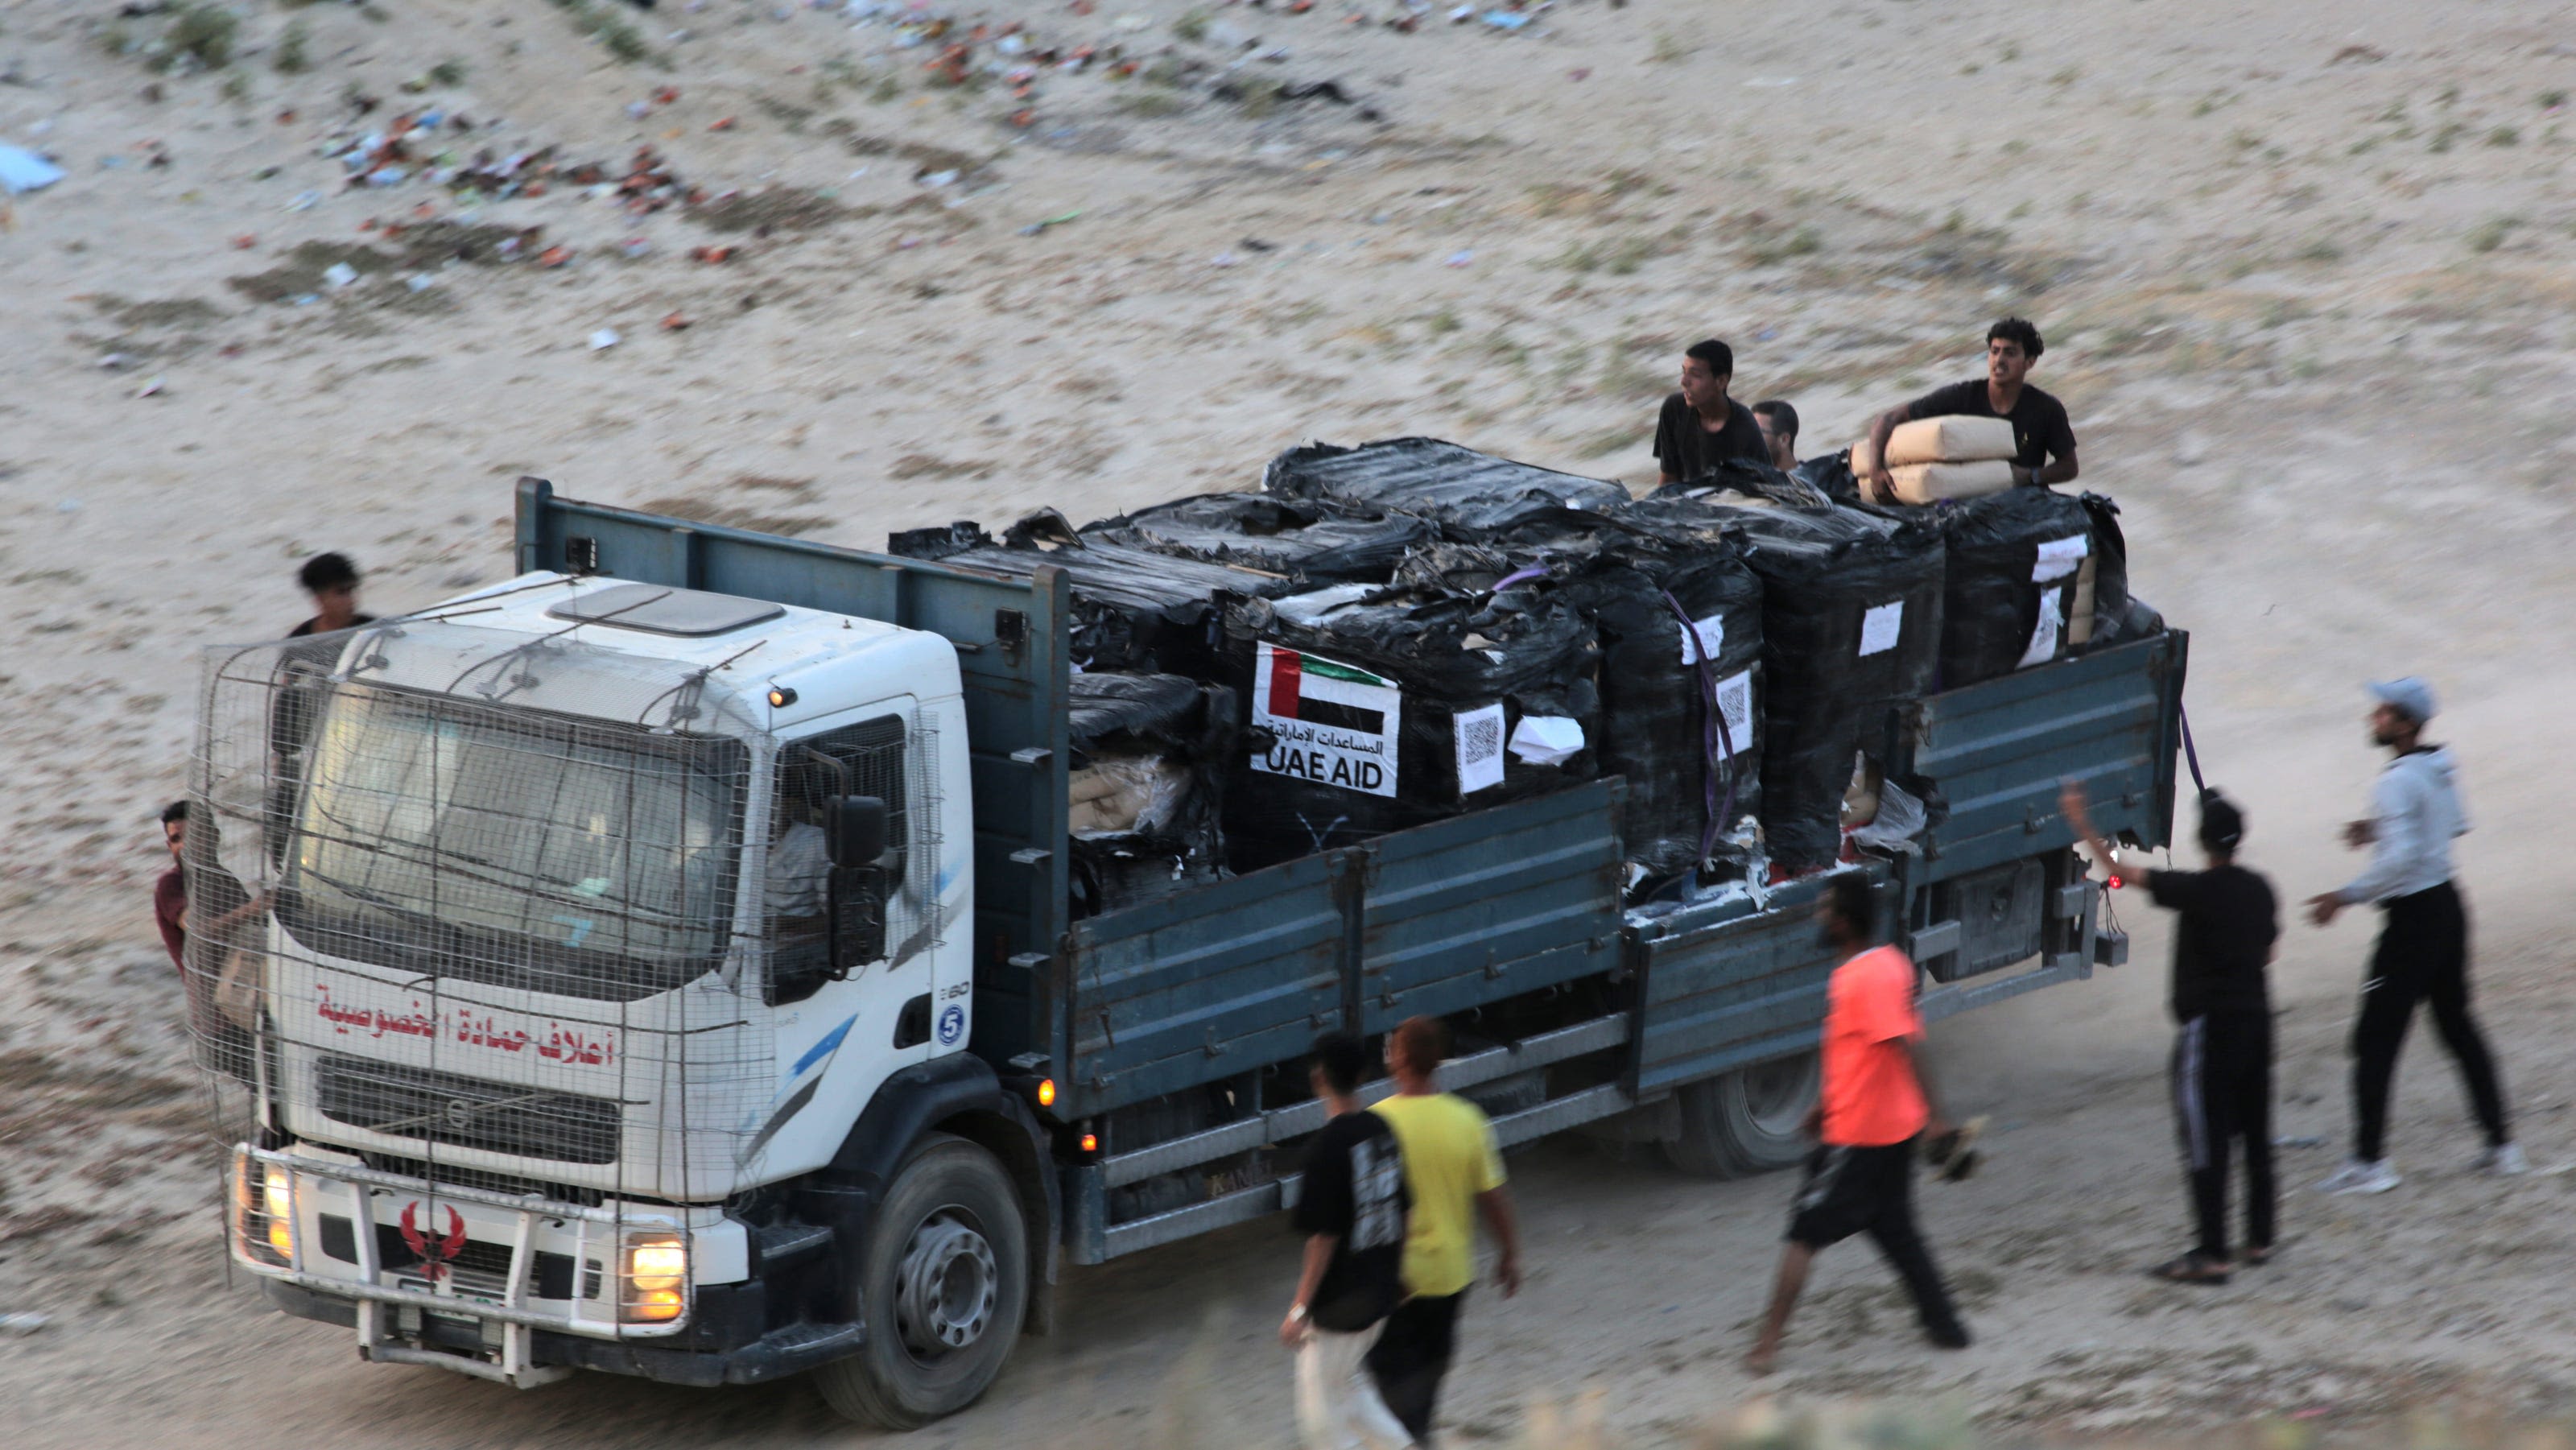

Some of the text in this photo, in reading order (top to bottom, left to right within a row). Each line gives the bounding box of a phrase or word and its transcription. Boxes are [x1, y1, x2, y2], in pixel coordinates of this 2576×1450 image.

[1316, 732, 1384, 755] المساعدات
[1265, 746, 1383, 790] UAE AID
[316, 983, 613, 1066] أعلاف حمادة اخصوصية
[943, 1014, 958, 1038] 5
